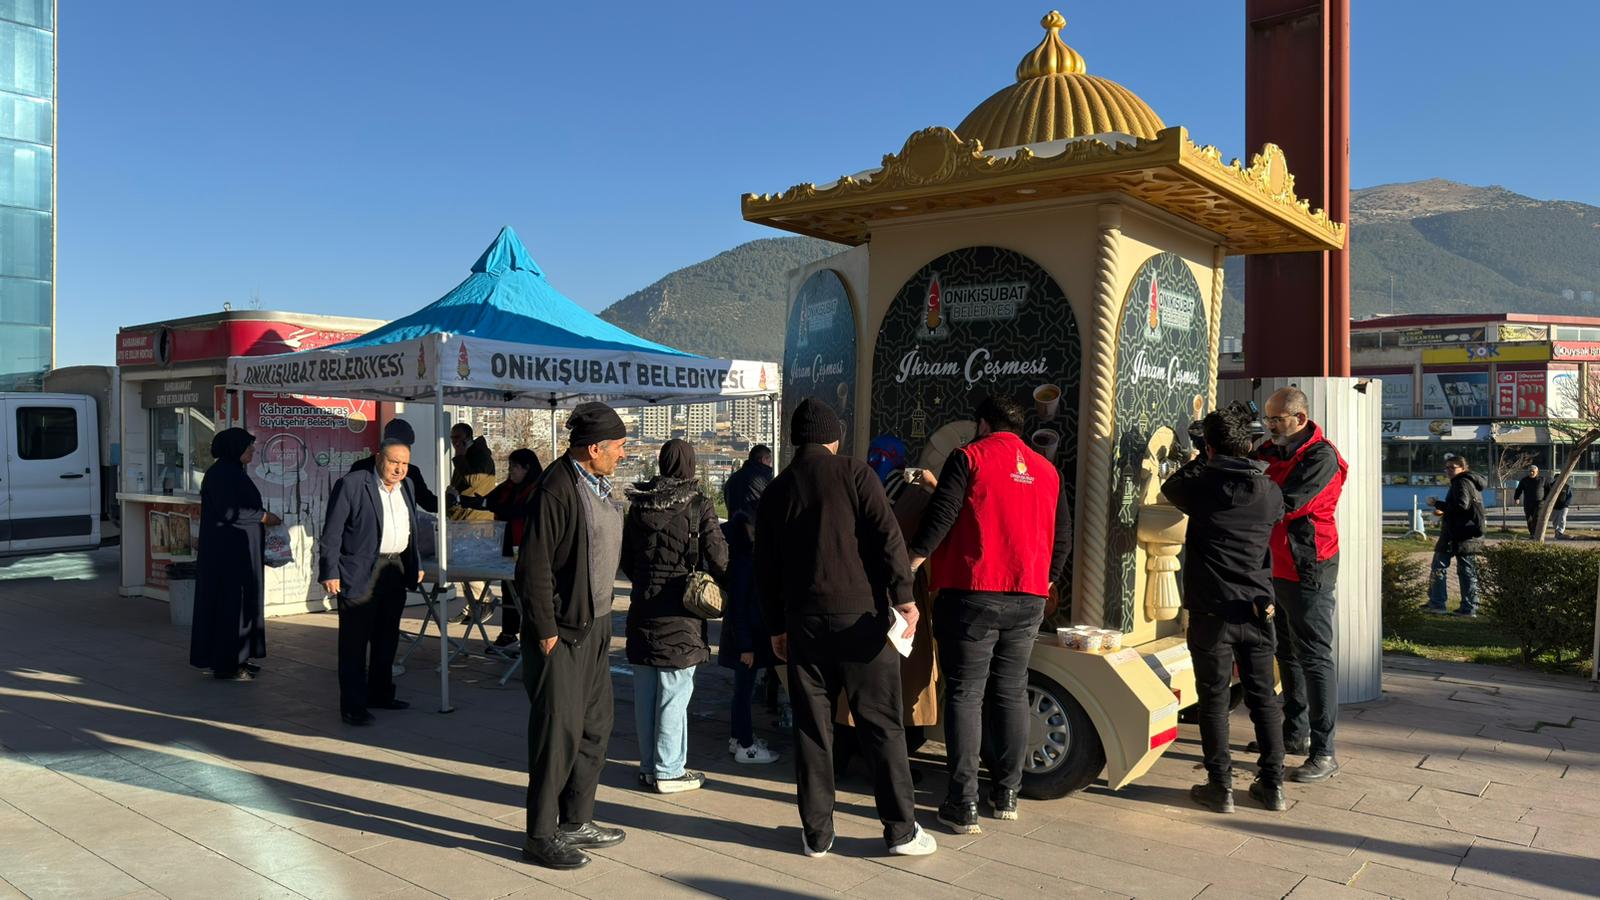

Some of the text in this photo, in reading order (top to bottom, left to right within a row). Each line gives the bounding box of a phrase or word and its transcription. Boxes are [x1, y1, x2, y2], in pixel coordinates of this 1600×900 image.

[895, 345, 1048, 391] İkram Çeşmesi
[261, 403, 348, 417] Kahramanmaraş
[261, 417, 305, 428] Büyükşehir
